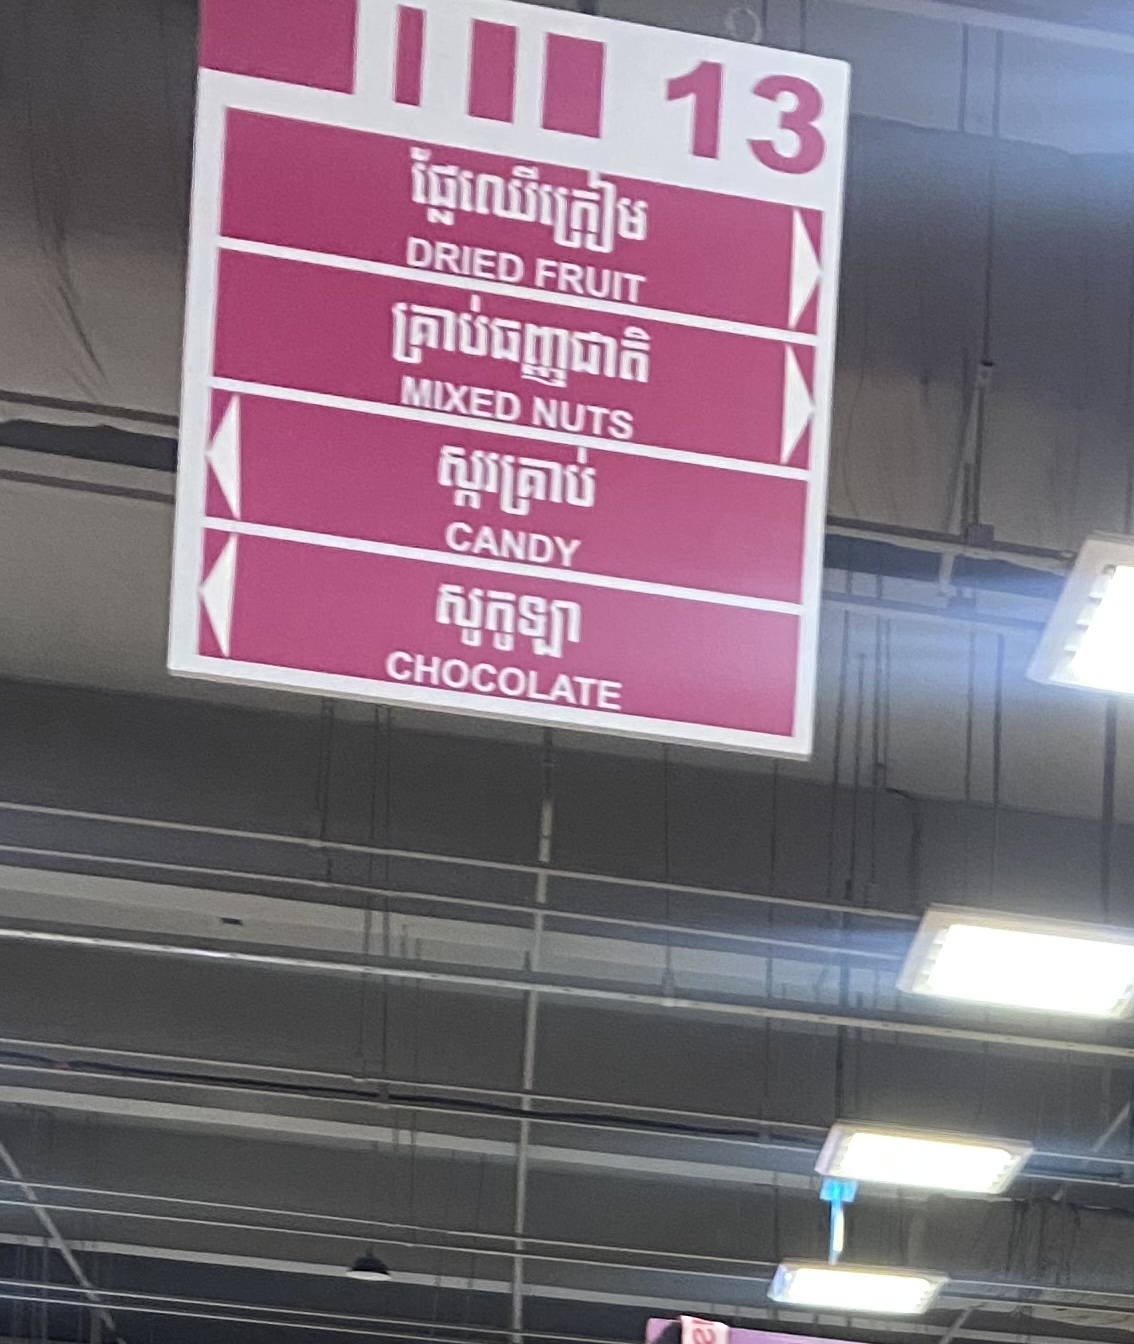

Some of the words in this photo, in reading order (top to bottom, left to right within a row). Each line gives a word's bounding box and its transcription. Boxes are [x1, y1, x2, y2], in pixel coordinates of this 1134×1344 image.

[665, 60, 827, 176] 13
[406, 236, 524, 283] DRIED
[534, 257, 647, 303] FRUIT
[400, 375, 521, 422] MIXED
[532, 396, 634, 439] NUTS
[445, 521, 581, 567] CANDY
[436, 583, 582, 658] សូកូឡា
[385, 651, 622, 710] CHOCOLATE
